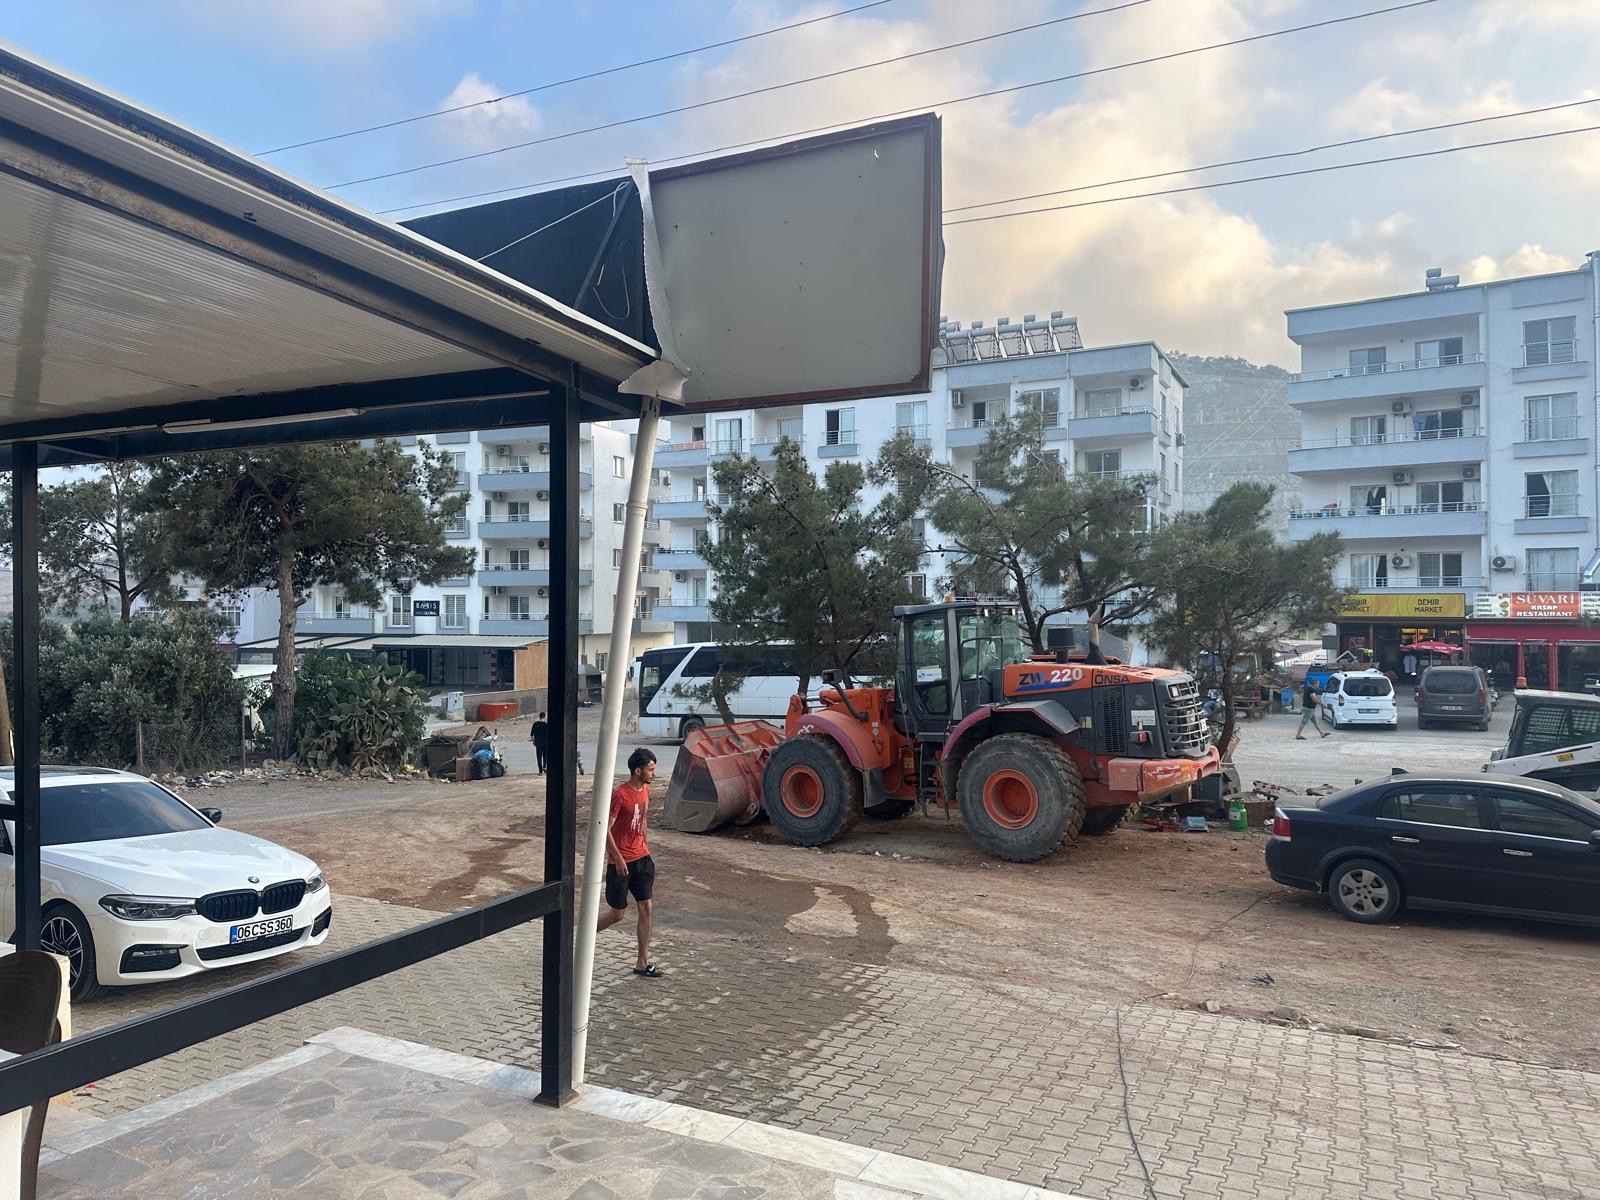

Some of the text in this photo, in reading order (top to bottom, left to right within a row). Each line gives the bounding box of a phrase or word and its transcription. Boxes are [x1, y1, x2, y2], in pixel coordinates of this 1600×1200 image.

[1417, 598, 1440, 606] DEMİR
[1516, 592, 1575, 604] SÜVARİ
[1050, 667, 1083, 683] 220
[1094, 670, 1130, 684] ÖNSA
